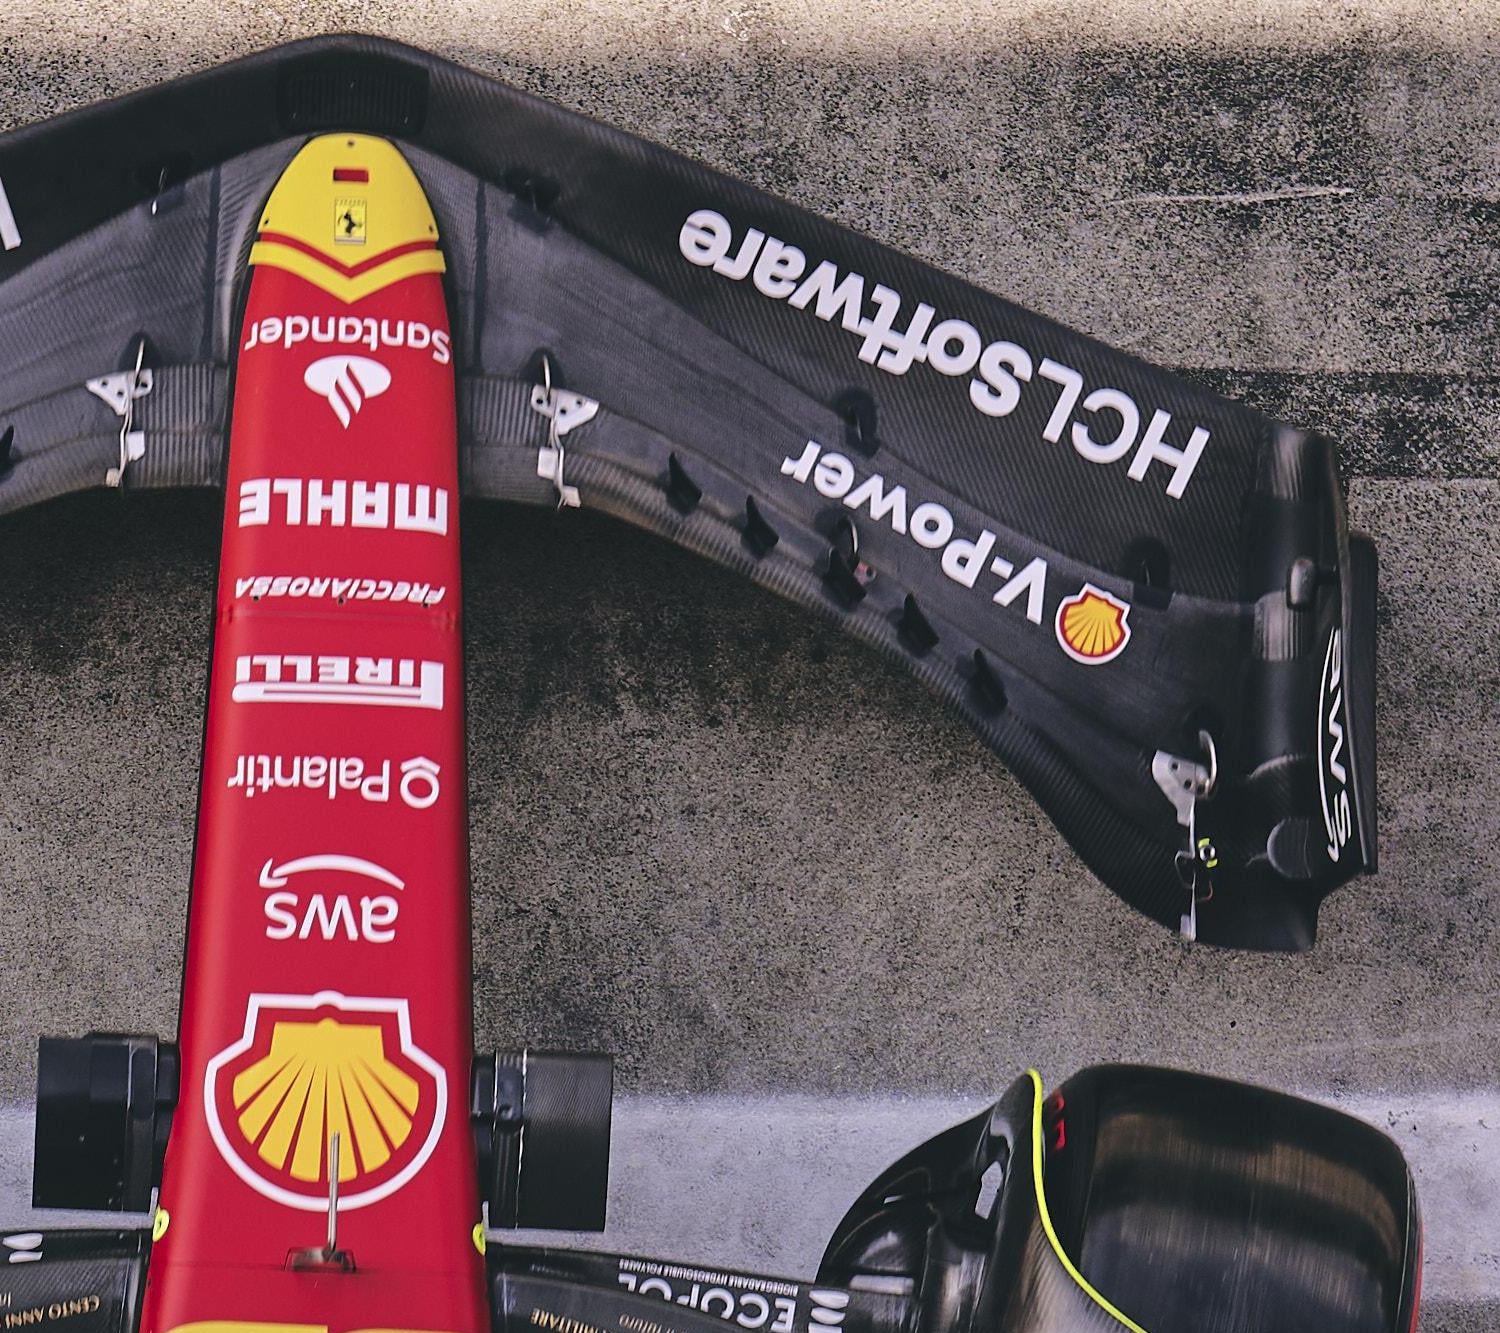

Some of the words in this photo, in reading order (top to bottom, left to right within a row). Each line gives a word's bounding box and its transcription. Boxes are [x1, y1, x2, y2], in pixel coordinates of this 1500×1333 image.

[244, 315, 451, 365] Santander
[678, 208, 1211, 500] HCLSoftware
[238, 477, 449, 536] MAHLE
[780, 441, 1047, 625] V-Power
[231, 654, 445, 711] PIRELLI
[227, 754, 391, 803] Palantir
[262, 890, 399, 944] aws
[5, 1305, 44, 1329] ANNI
[48, 1294, 100, 1320] CENTO
